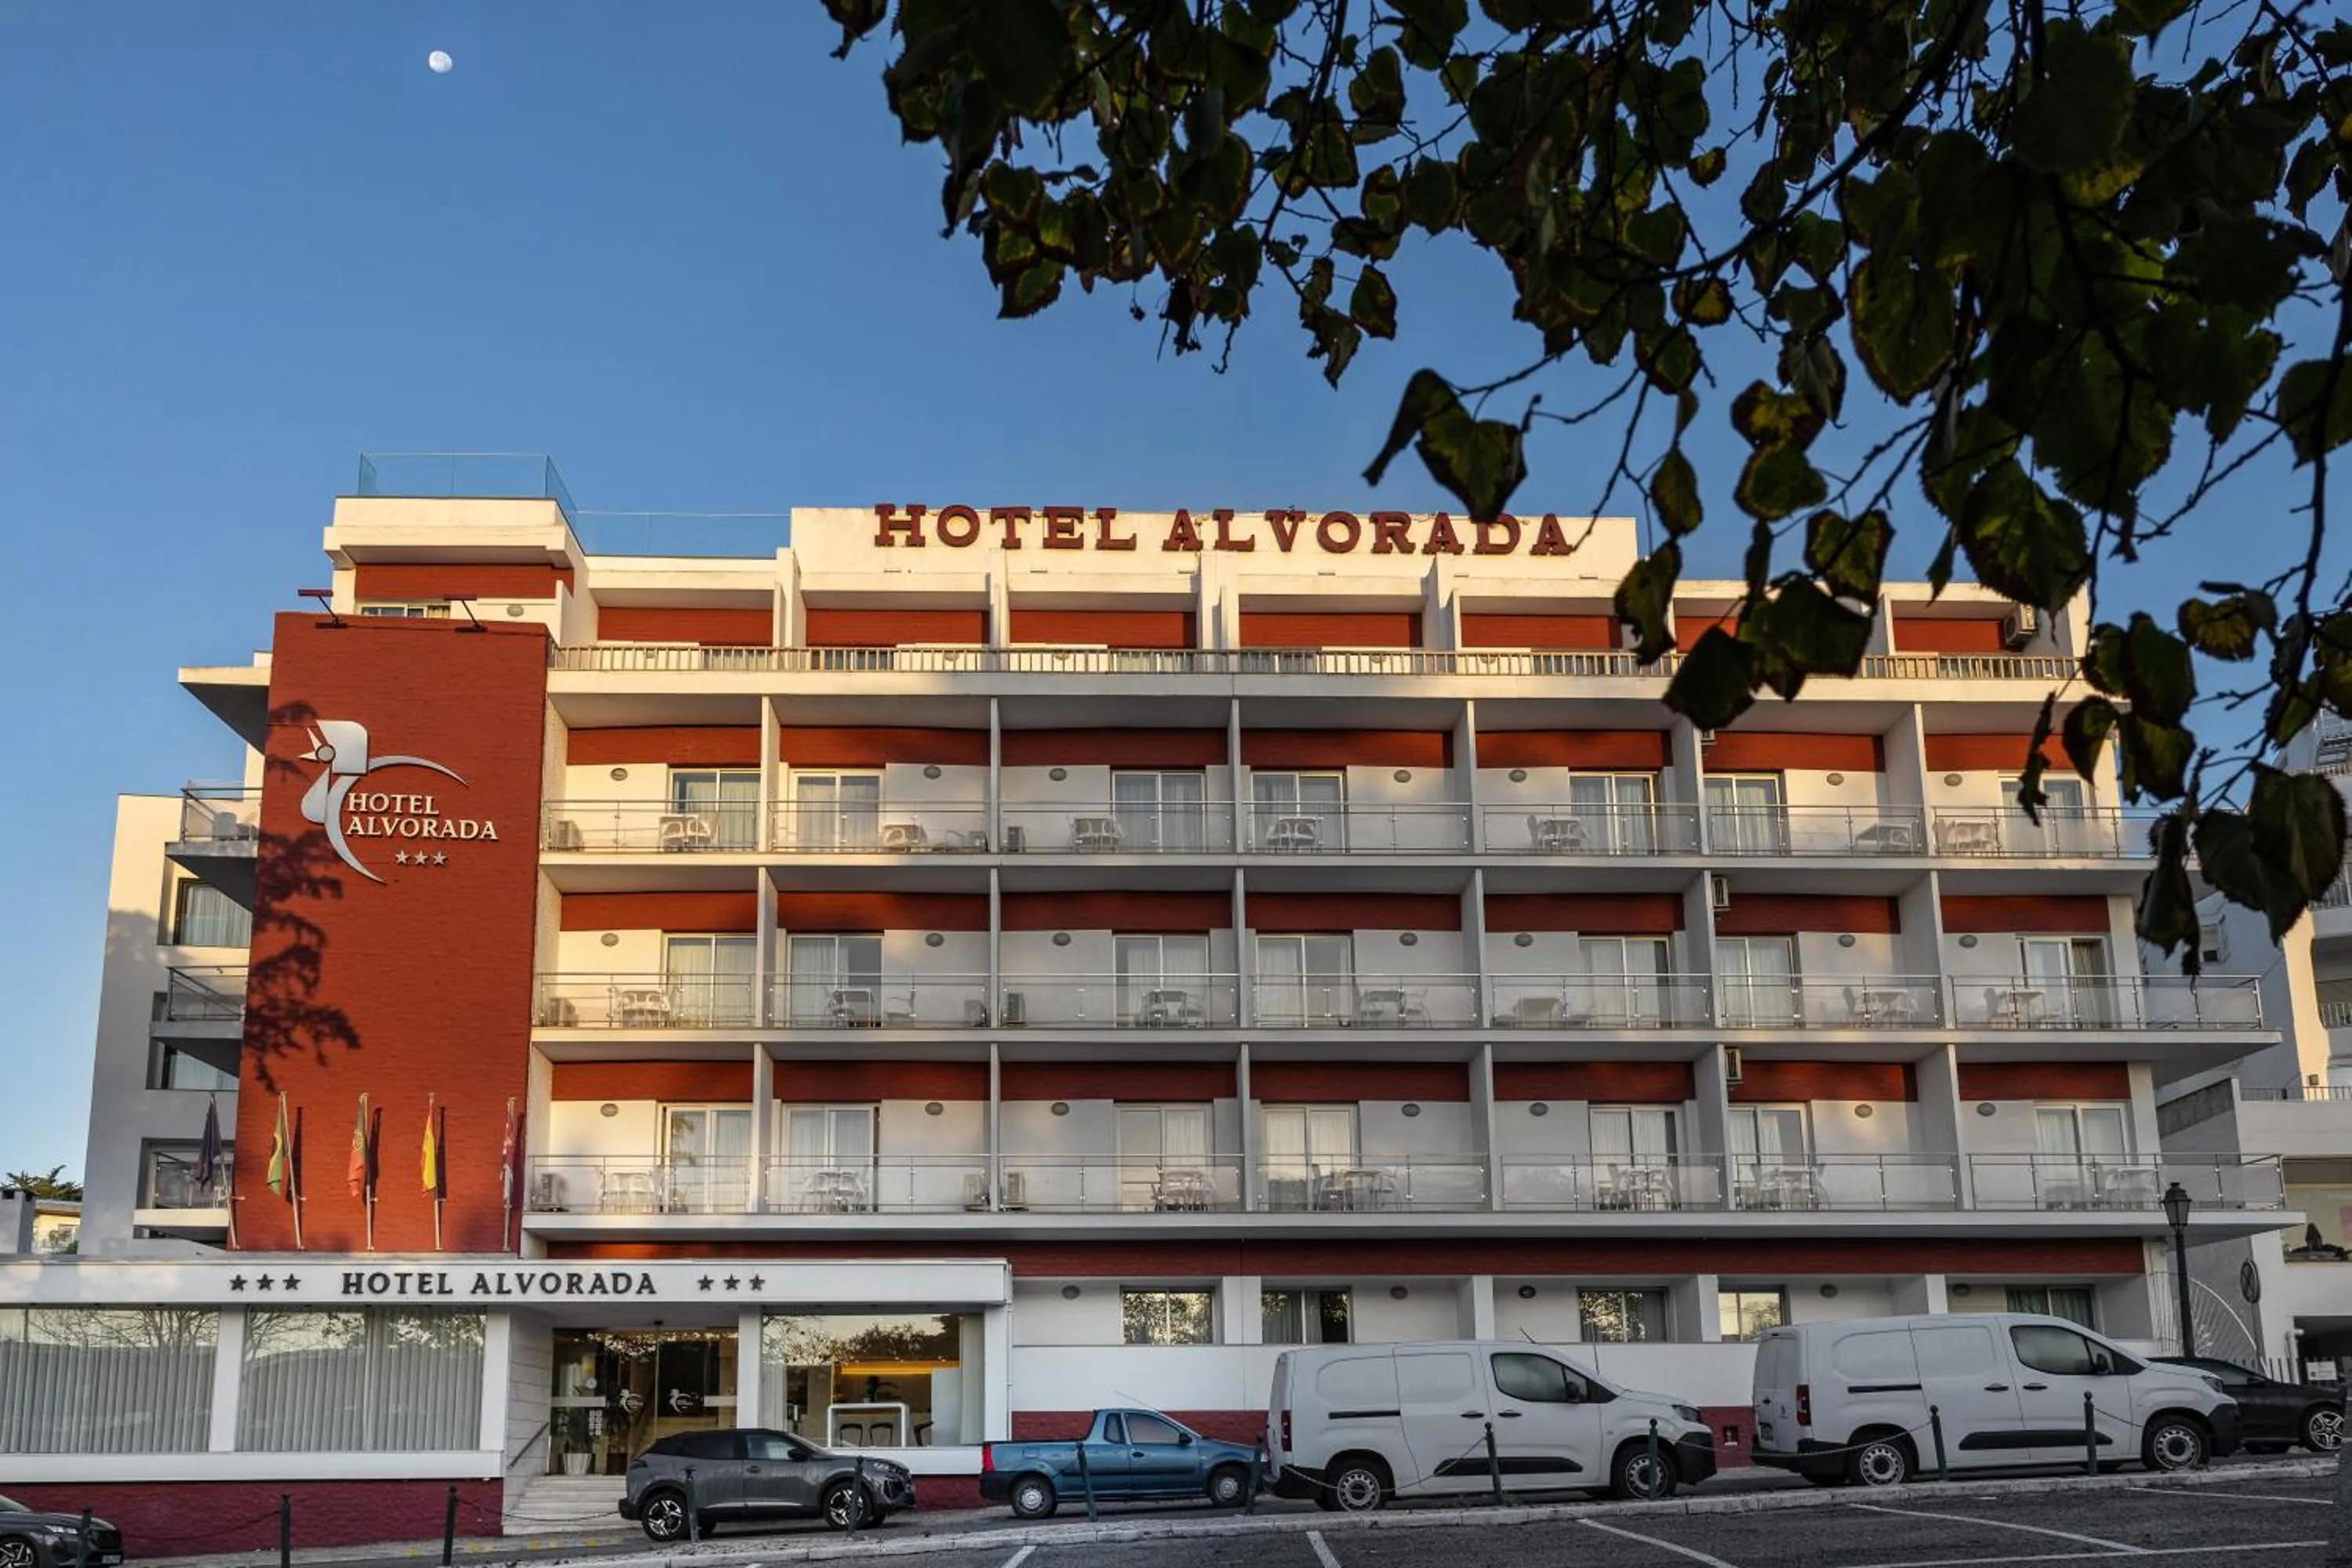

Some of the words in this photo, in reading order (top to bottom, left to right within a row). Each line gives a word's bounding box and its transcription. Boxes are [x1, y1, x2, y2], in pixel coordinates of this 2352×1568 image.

[874, 503, 1137, 551] HOTEL
[1162, 508, 1573, 555] ALVORADA
[347, 792, 440, 815] HOTEL
[346, 817, 499, 841] ALVORADA
[341, 1272, 454, 1295] HOTEL
[470, 1272, 657, 1295] ALVORADA
